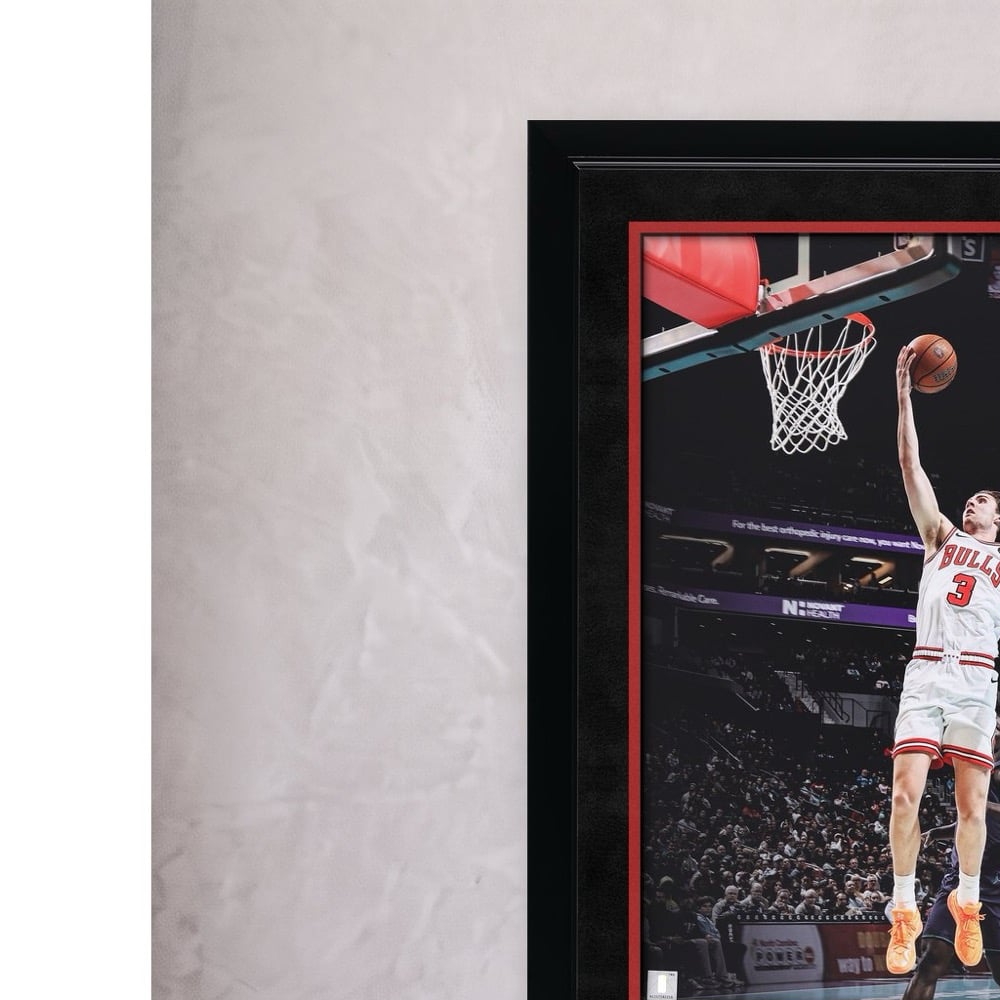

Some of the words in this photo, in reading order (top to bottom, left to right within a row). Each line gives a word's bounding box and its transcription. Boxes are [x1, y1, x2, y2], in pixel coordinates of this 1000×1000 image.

[732, 520, 746, 529] For
[747, 521, 761, 531] the
[761, 523, 779, 533] best
[946, 573, 977, 608] 3
